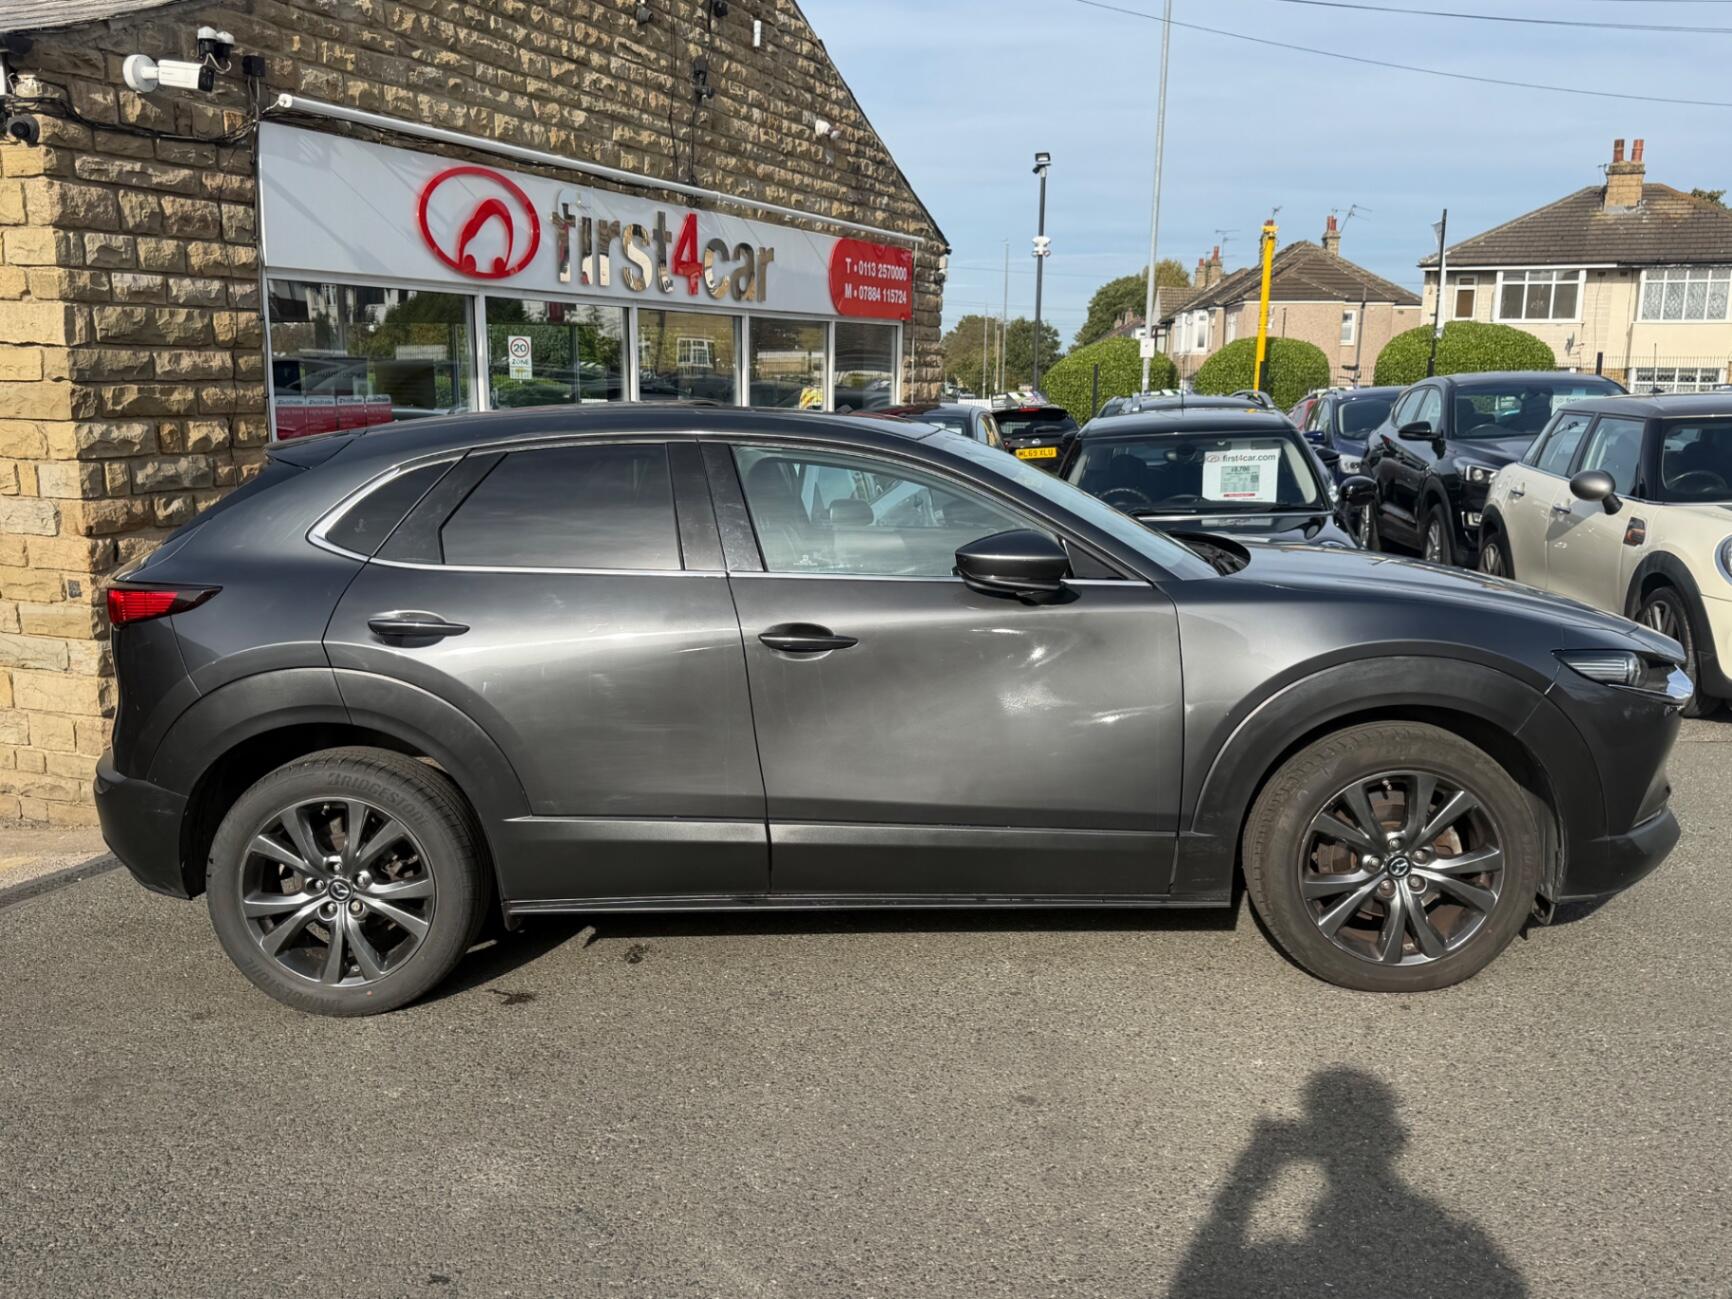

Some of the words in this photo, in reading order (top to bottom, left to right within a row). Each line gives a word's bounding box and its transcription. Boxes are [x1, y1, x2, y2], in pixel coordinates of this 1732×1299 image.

[552, 188, 774, 304] first4car
[845, 257, 851, 273] T
[858, 260, 876, 276] 0113
[844, 283, 853, 299] M
[858, 286, 880, 301] 07884
[513, 343, 528, 353] 20
[1222, 454, 1276, 463] first4car.com
